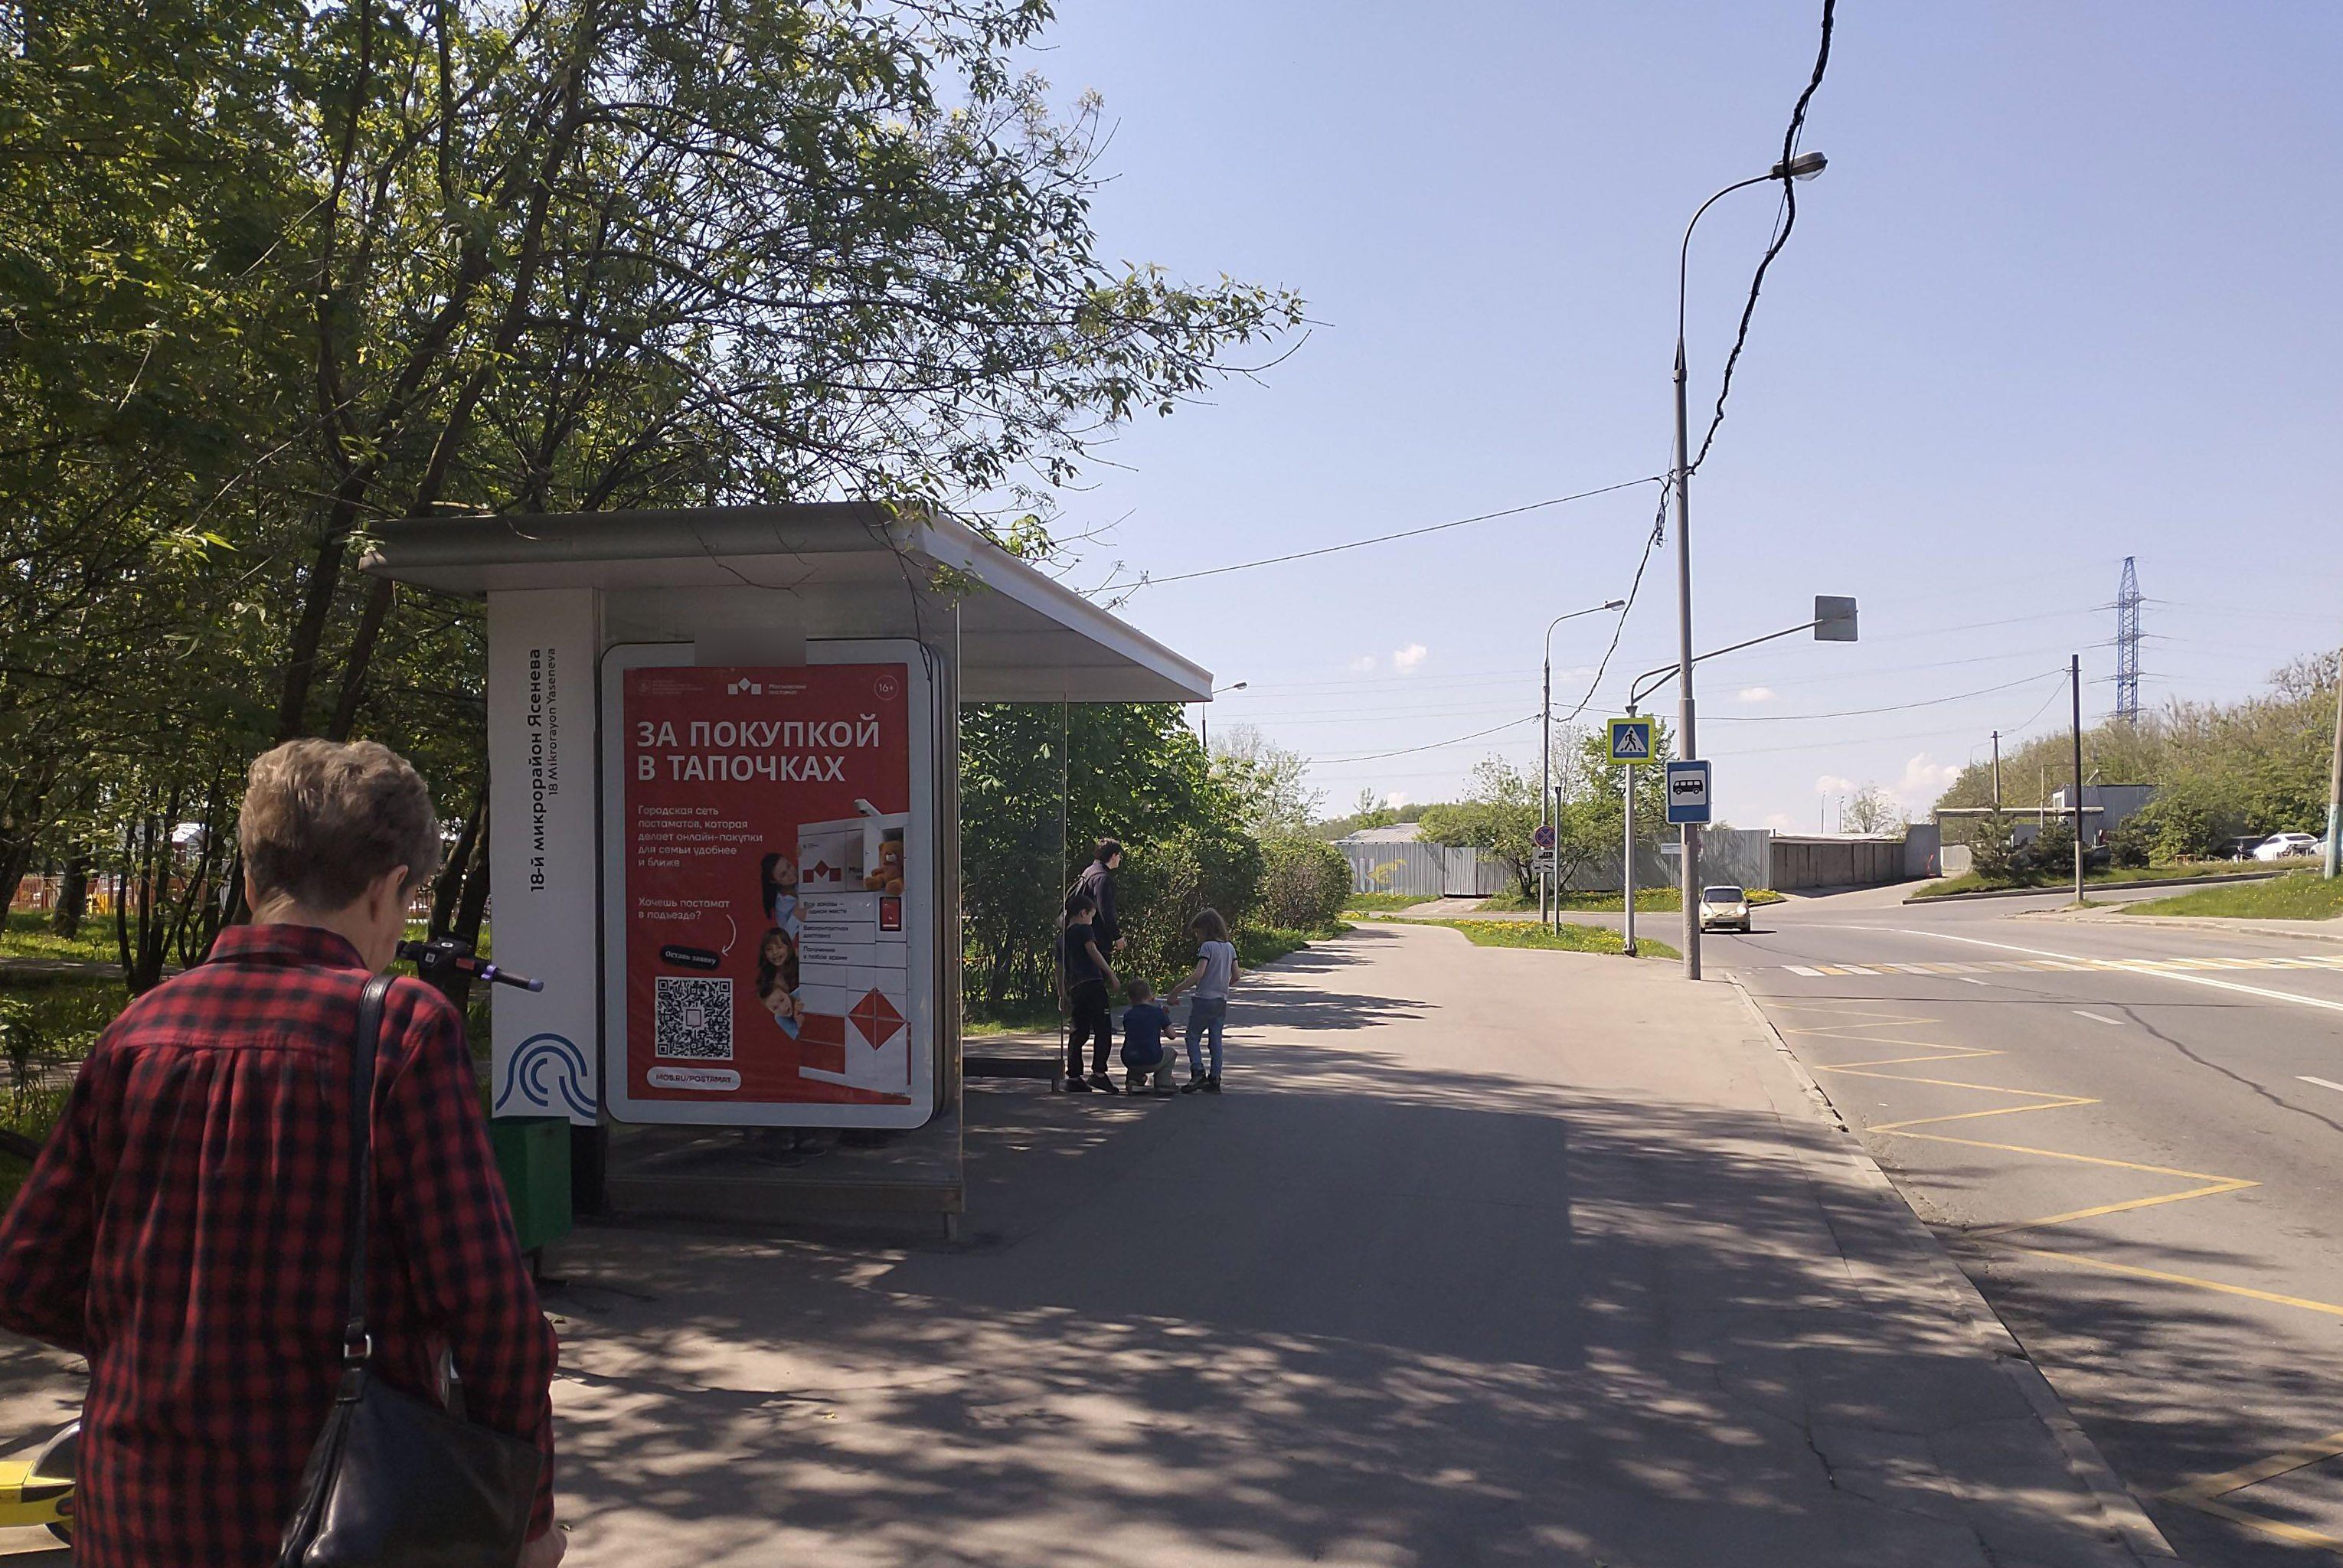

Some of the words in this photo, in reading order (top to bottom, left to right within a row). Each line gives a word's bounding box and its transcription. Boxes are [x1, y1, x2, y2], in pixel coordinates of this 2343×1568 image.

[547, 648, 557, 704] Yaseneva
[528, 648, 542, 727] Ясенева
[637, 721, 678, 747] ЗА
[690, 713, 880, 747] ПОКУПКОЙ
[547, 707, 559, 781] Mikrorayon
[639, 756, 656, 781] В
[667, 755, 846, 782] ТАПОЧКАХ
[528, 733, 547, 851] микрорайон
[548, 783, 558, 795] 18
[638, 805, 693, 815] Городская
[695, 807, 719, 815] сеть
[638, 821, 702, 829] постаматов,
[704, 821, 748, 830] которая
[638, 833, 674, 841] делает
[676, 832, 763, 843] онлайн-покупки
[638, 846, 656, 854] для
[693, 845, 737, 856] удобнее
[648, 858, 680, 867] ближе
[529, 858, 545, 893] 18-й
[638, 897, 678, 907] Хочешь
[680, 900, 730, 908] постамат
[647, 910, 702, 920] подъезде?
